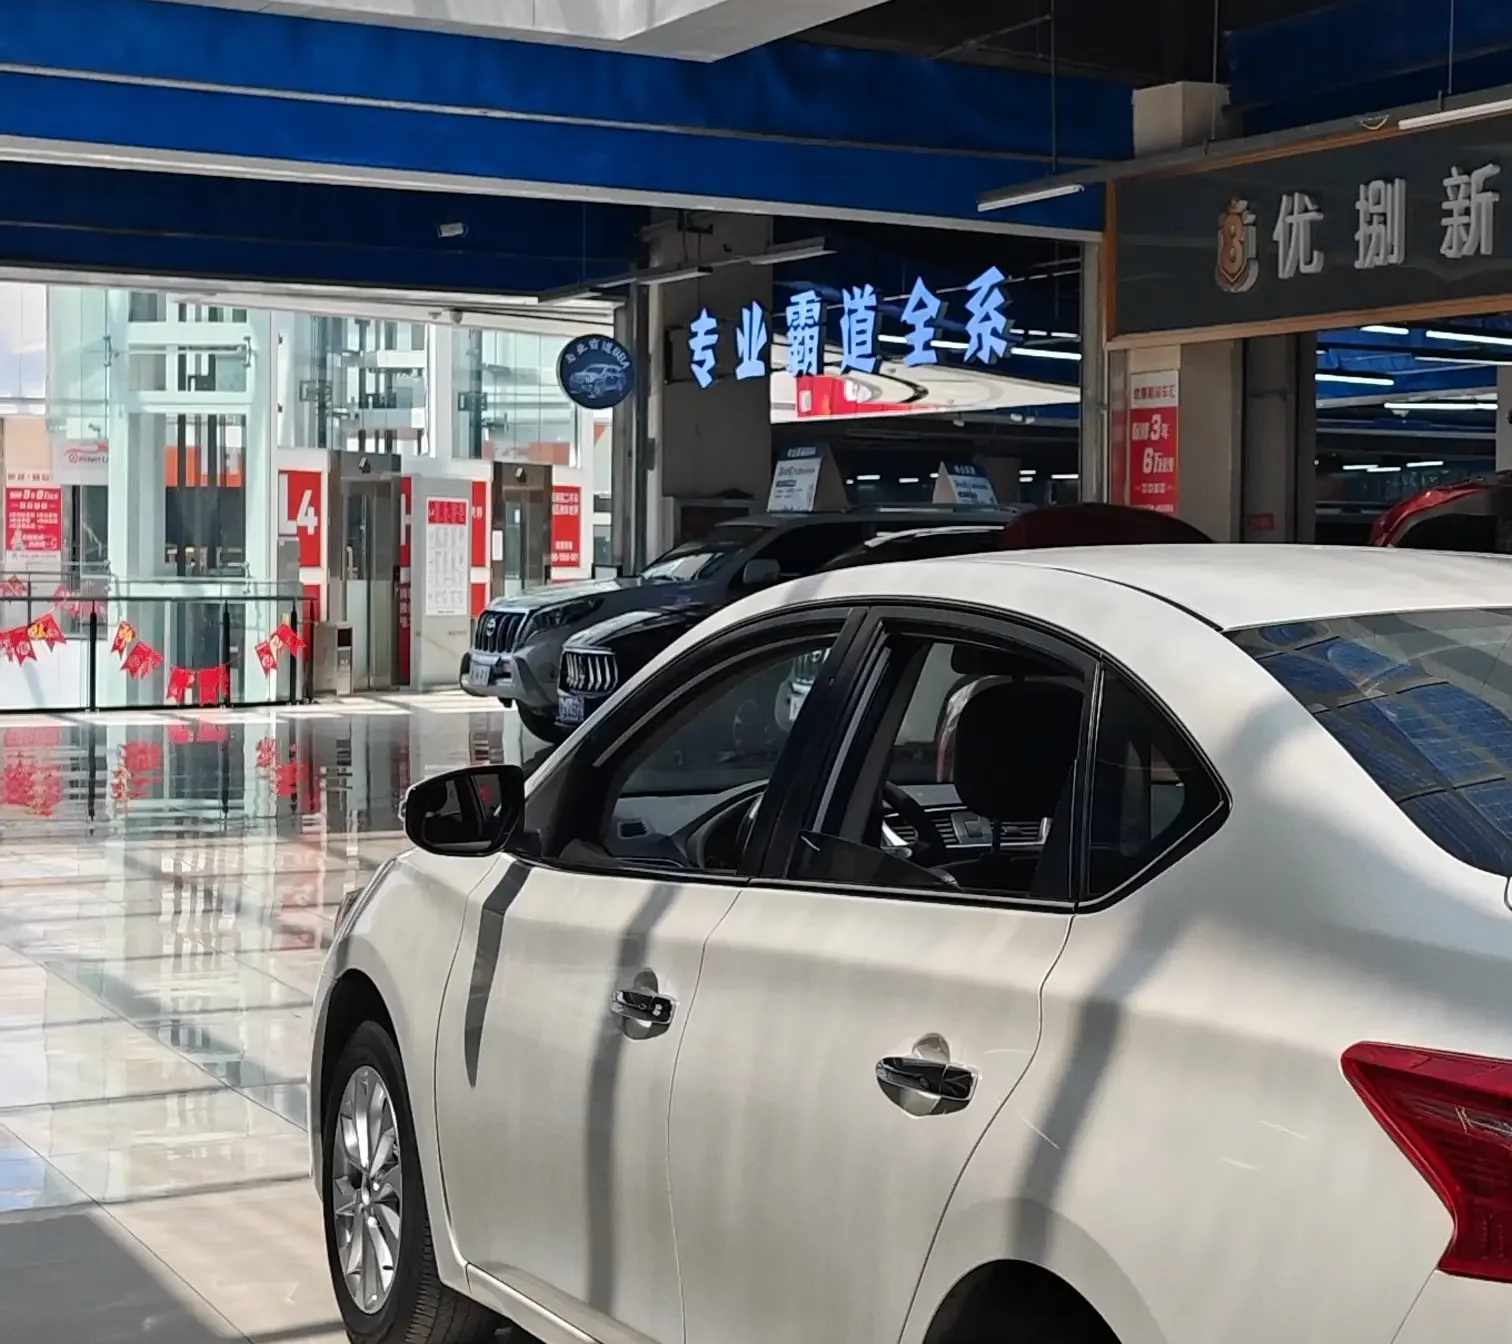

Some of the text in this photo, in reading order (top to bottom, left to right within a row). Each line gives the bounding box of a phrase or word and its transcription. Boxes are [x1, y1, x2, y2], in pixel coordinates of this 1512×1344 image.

[688, 265, 1008, 389] 专业霸道全系
[280, 473, 318, 536] L4
